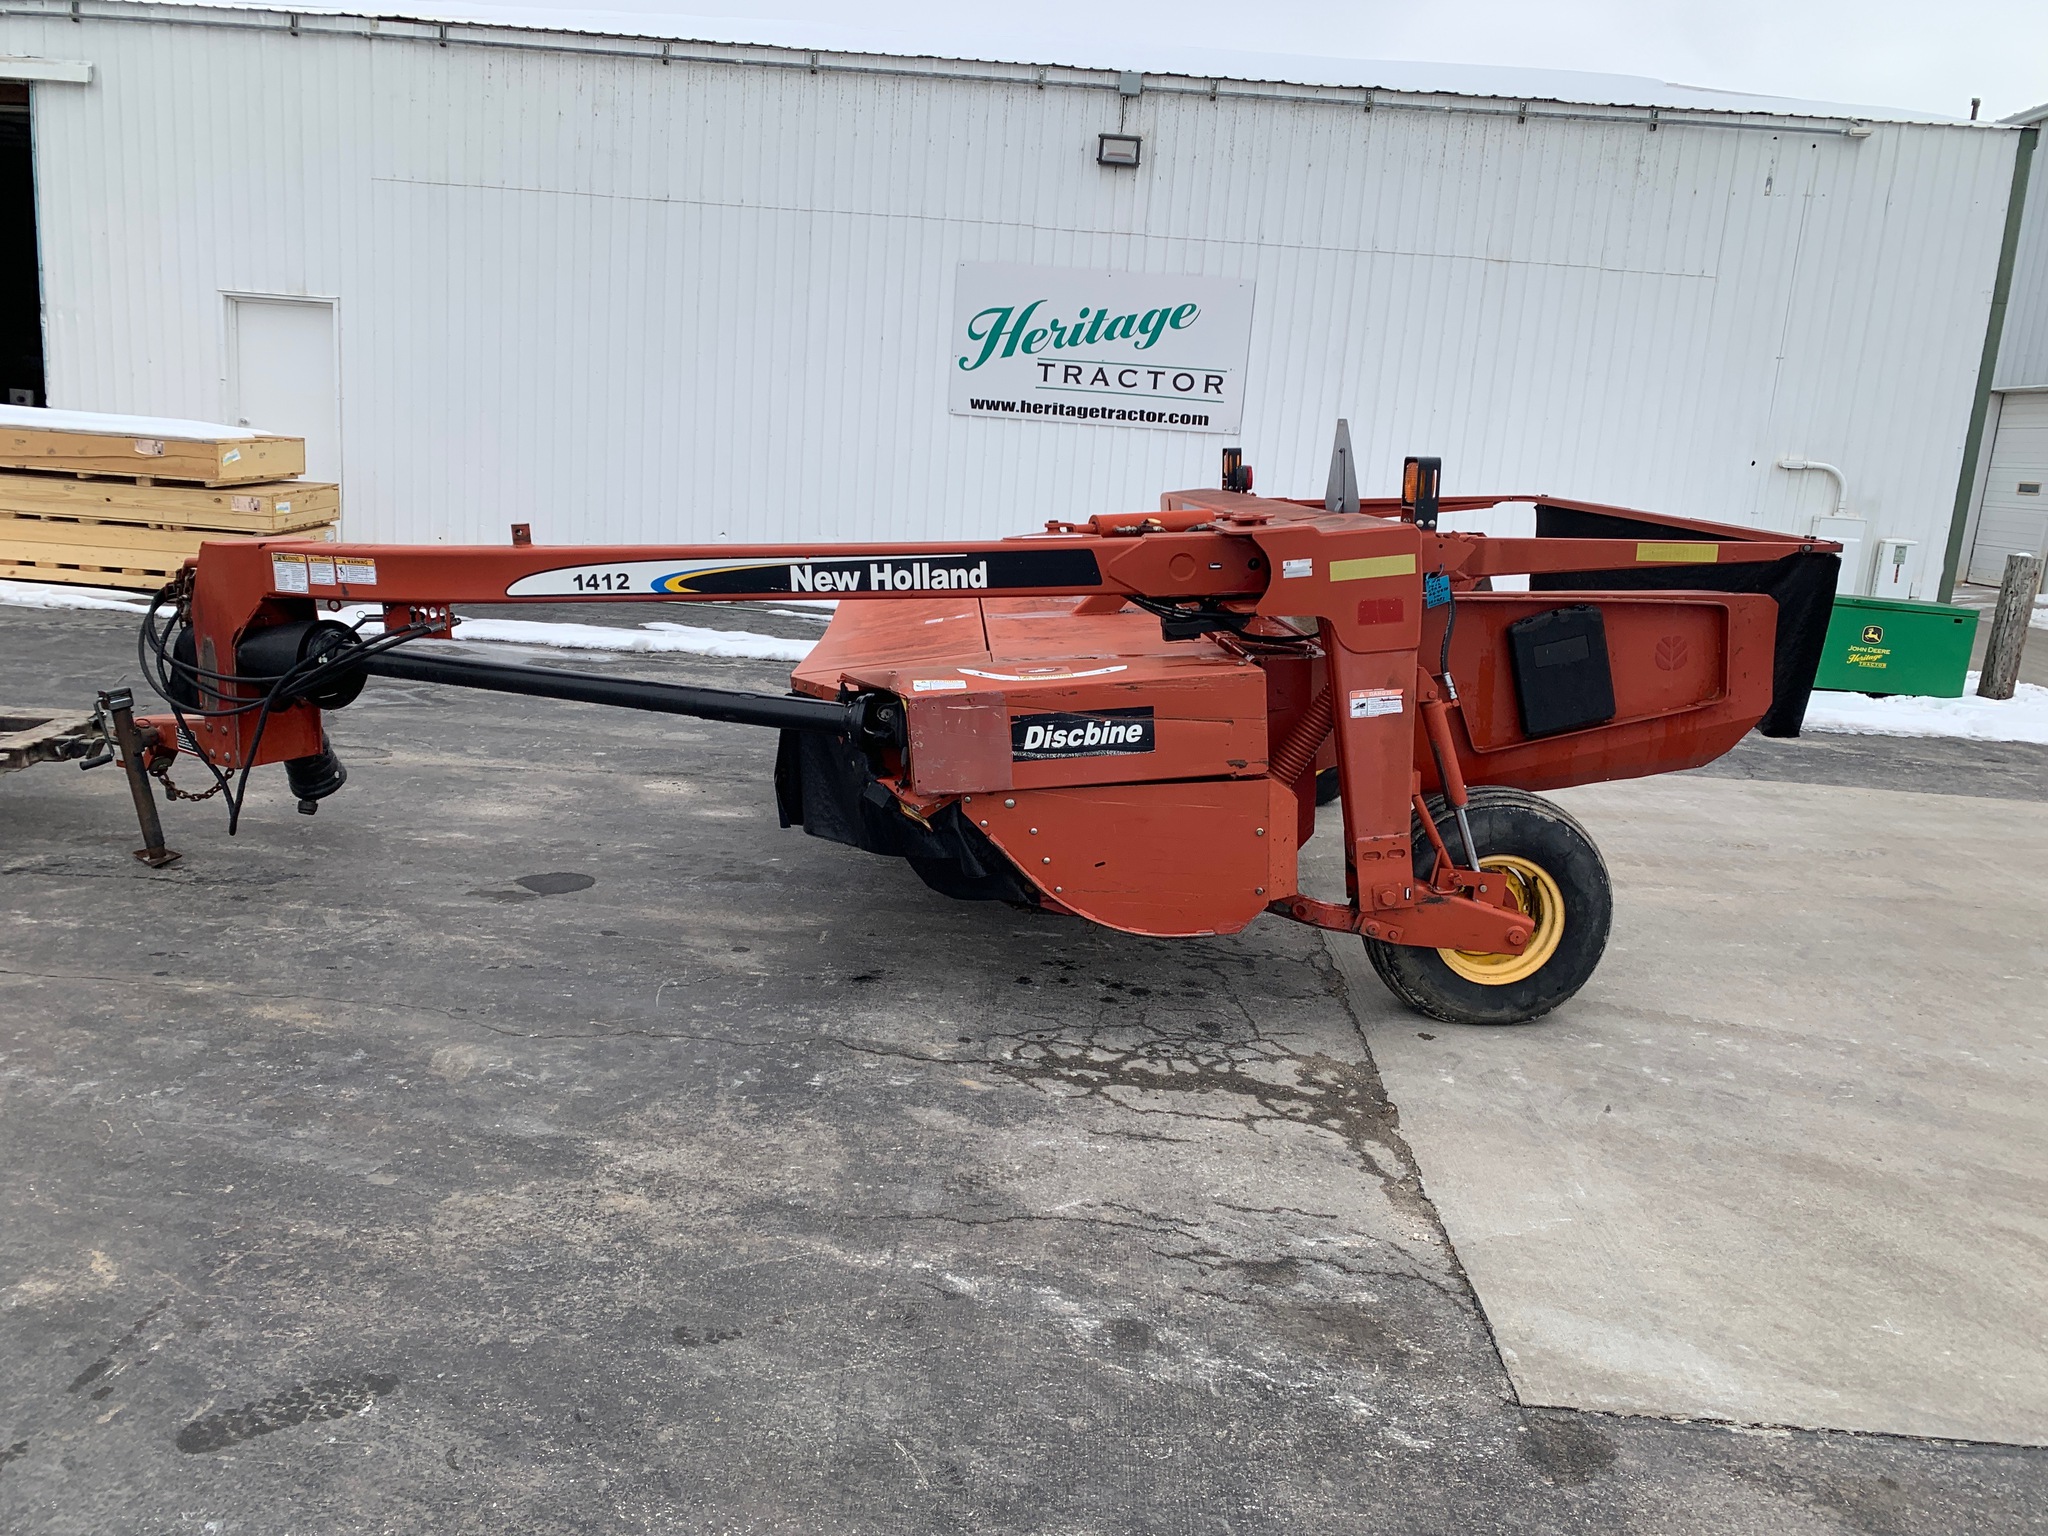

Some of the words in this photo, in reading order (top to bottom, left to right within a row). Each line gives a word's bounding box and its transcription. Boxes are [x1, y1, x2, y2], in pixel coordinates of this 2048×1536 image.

[958, 299, 1202, 371] Heritage
[1037, 363, 1224, 394] TRACTOR
[970, 398, 1209, 426] www.heritagetractor.com
[573, 573, 630, 591] 1412
[789, 565, 861, 592] New
[870, 561, 988, 591] Holland
[1023, 720, 1143, 750] Discbine
